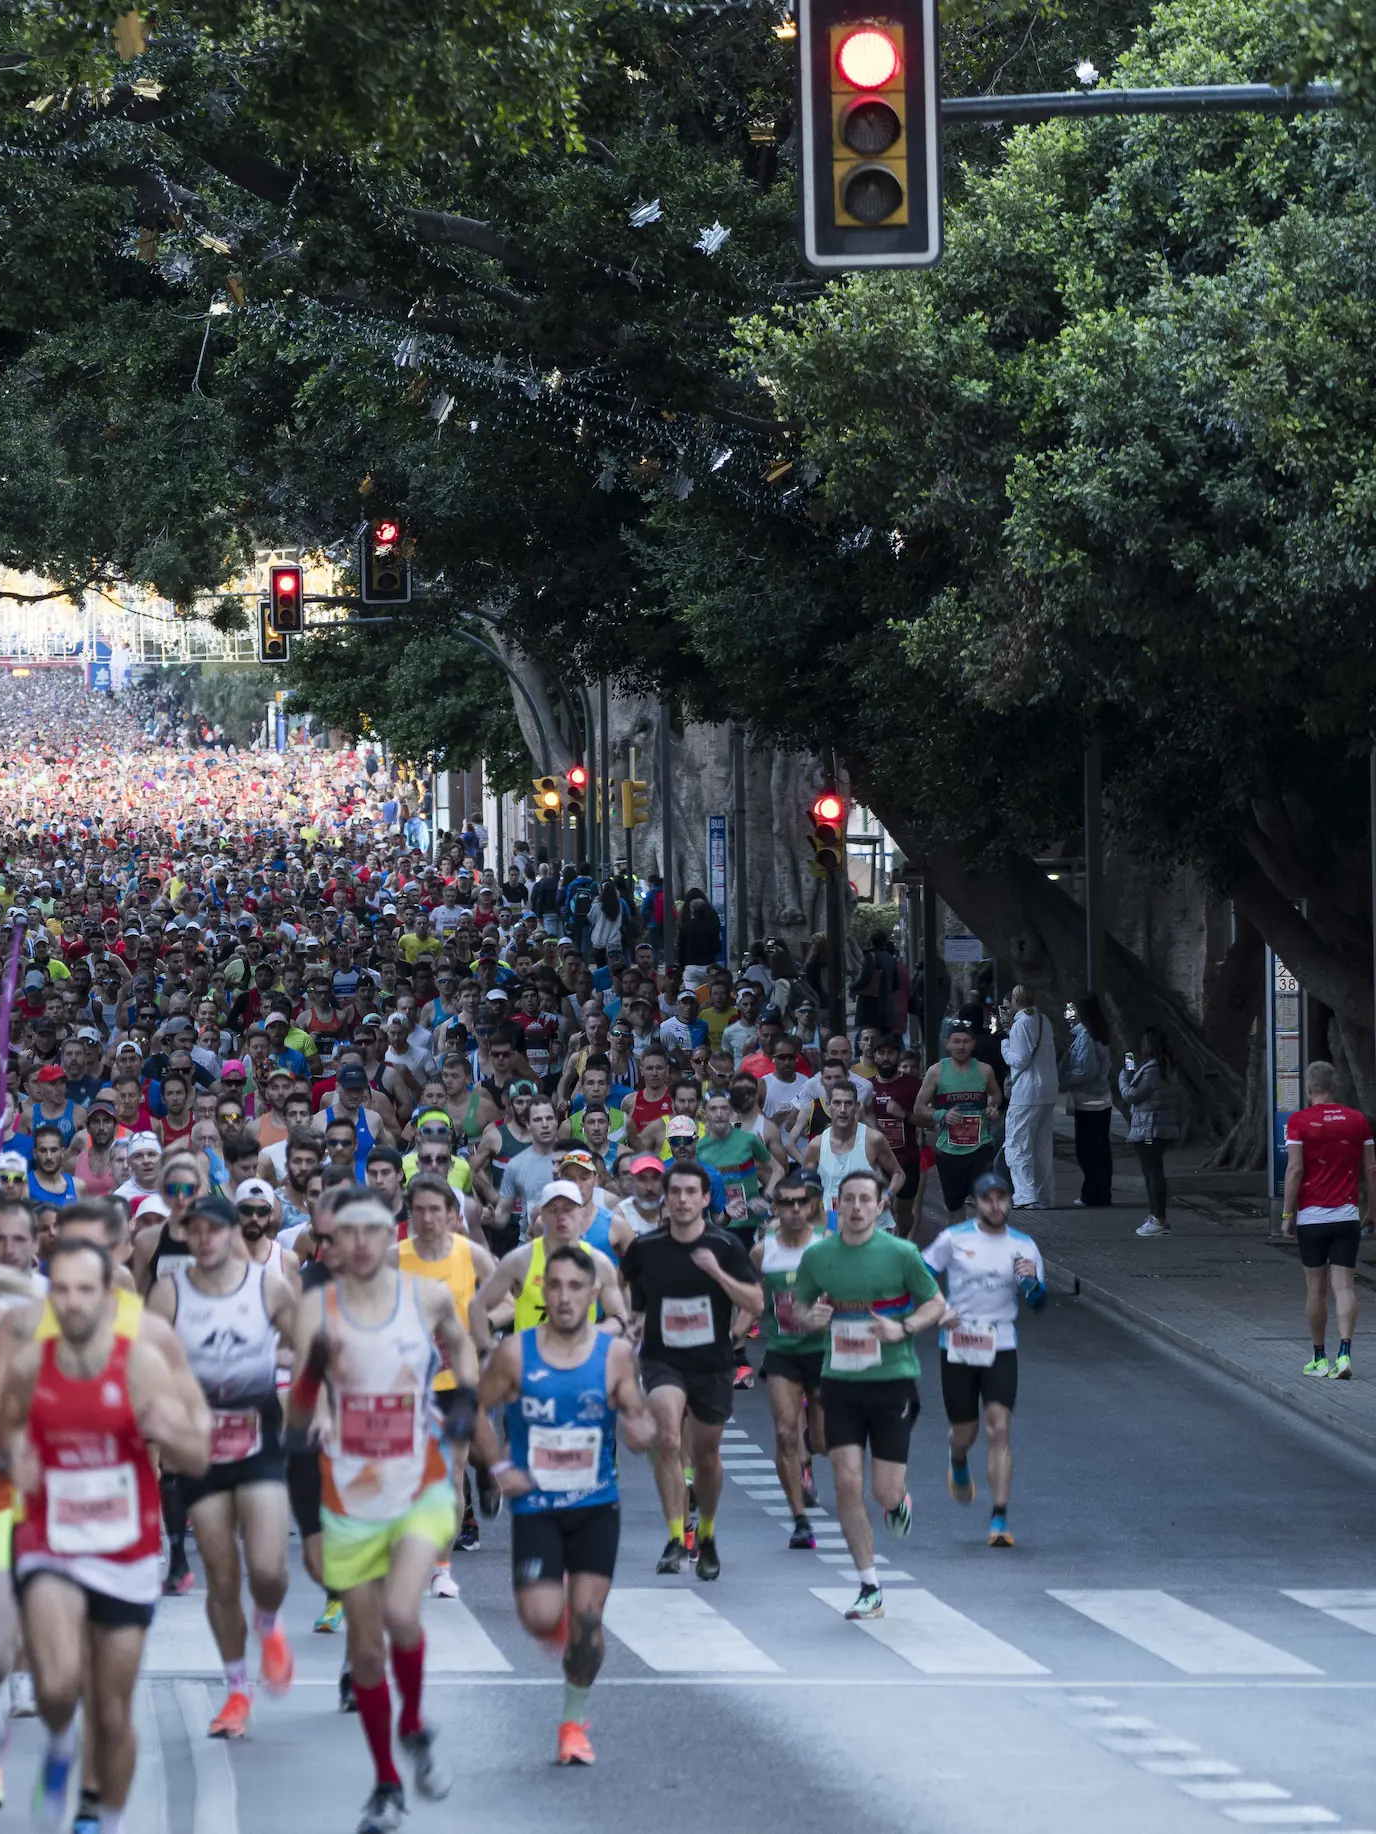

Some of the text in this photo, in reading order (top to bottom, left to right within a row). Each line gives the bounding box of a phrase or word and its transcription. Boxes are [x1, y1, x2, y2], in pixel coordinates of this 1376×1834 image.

[711, 819, 724, 829] BUS
[1279, 979, 1296, 991] 38
[946, 1092, 982, 1102] STROUD
[522, 1397, 556, 1422] DM
